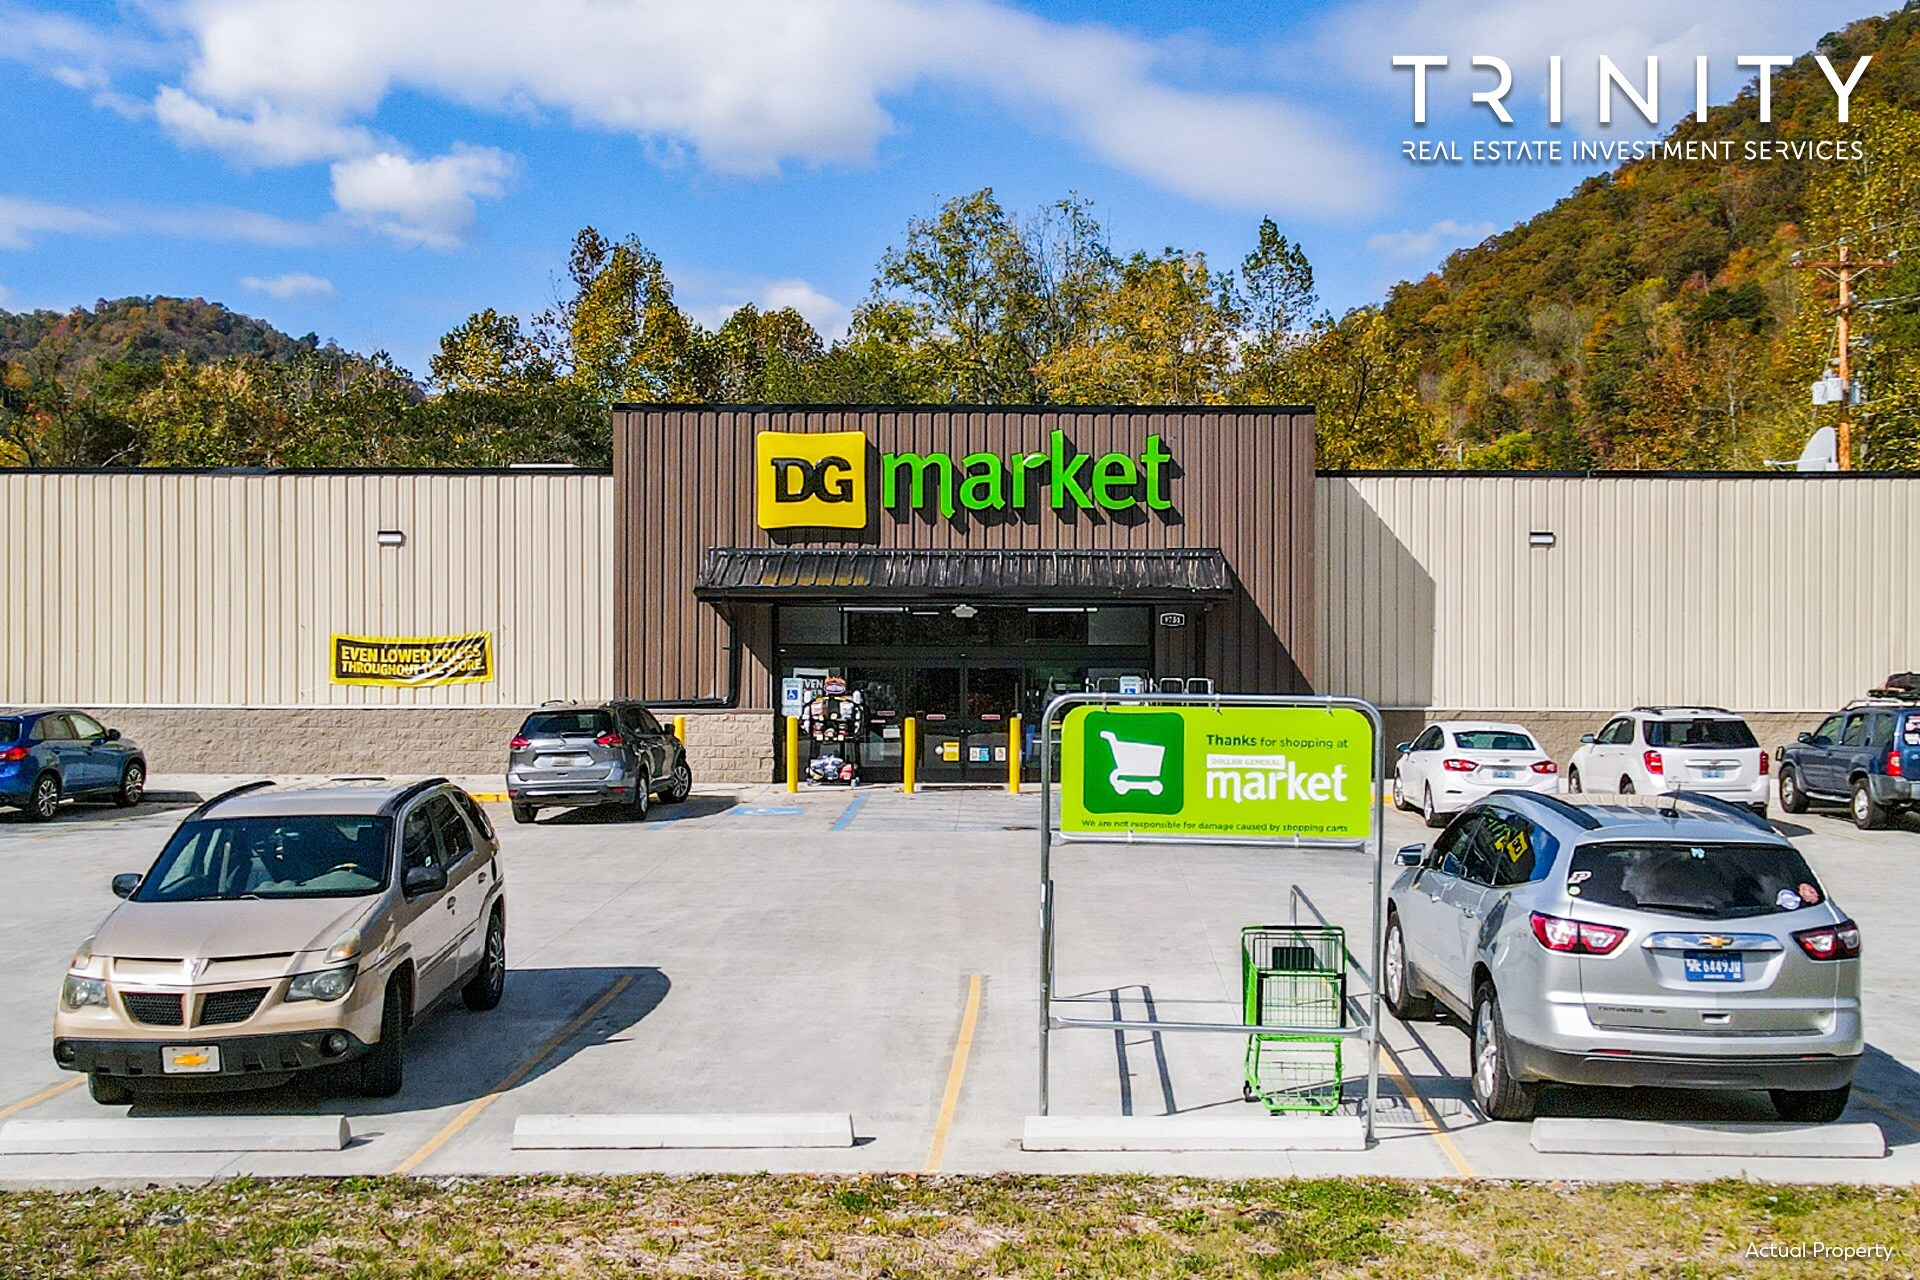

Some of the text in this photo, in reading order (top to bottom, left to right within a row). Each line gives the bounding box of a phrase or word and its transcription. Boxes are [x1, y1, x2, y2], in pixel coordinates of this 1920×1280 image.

[770, 429, 1172, 519] DG market
[341, 644, 482, 663] EVEN LOWER PRICES
[341, 660, 421, 676] THROUGHOUT
[802, 679, 824, 689] VEN
[1206, 734, 1348, 750] Thanks for shopping at
[1210, 757, 1281, 767] DOLLAR GENERAL
[1206, 760, 1348, 804] market
[1081, 819, 1096, 827] We
[1130, 820, 1181, 829] responsible
[1183, 821, 1196, 829] for
[1198, 822, 1233, 831] damage
[1236, 823, 1268, 831] caused
[1269, 823, 1280, 832] by
[1282, 823, 1324, 833] shopping
[1325, 824, 1348, 832] carts
